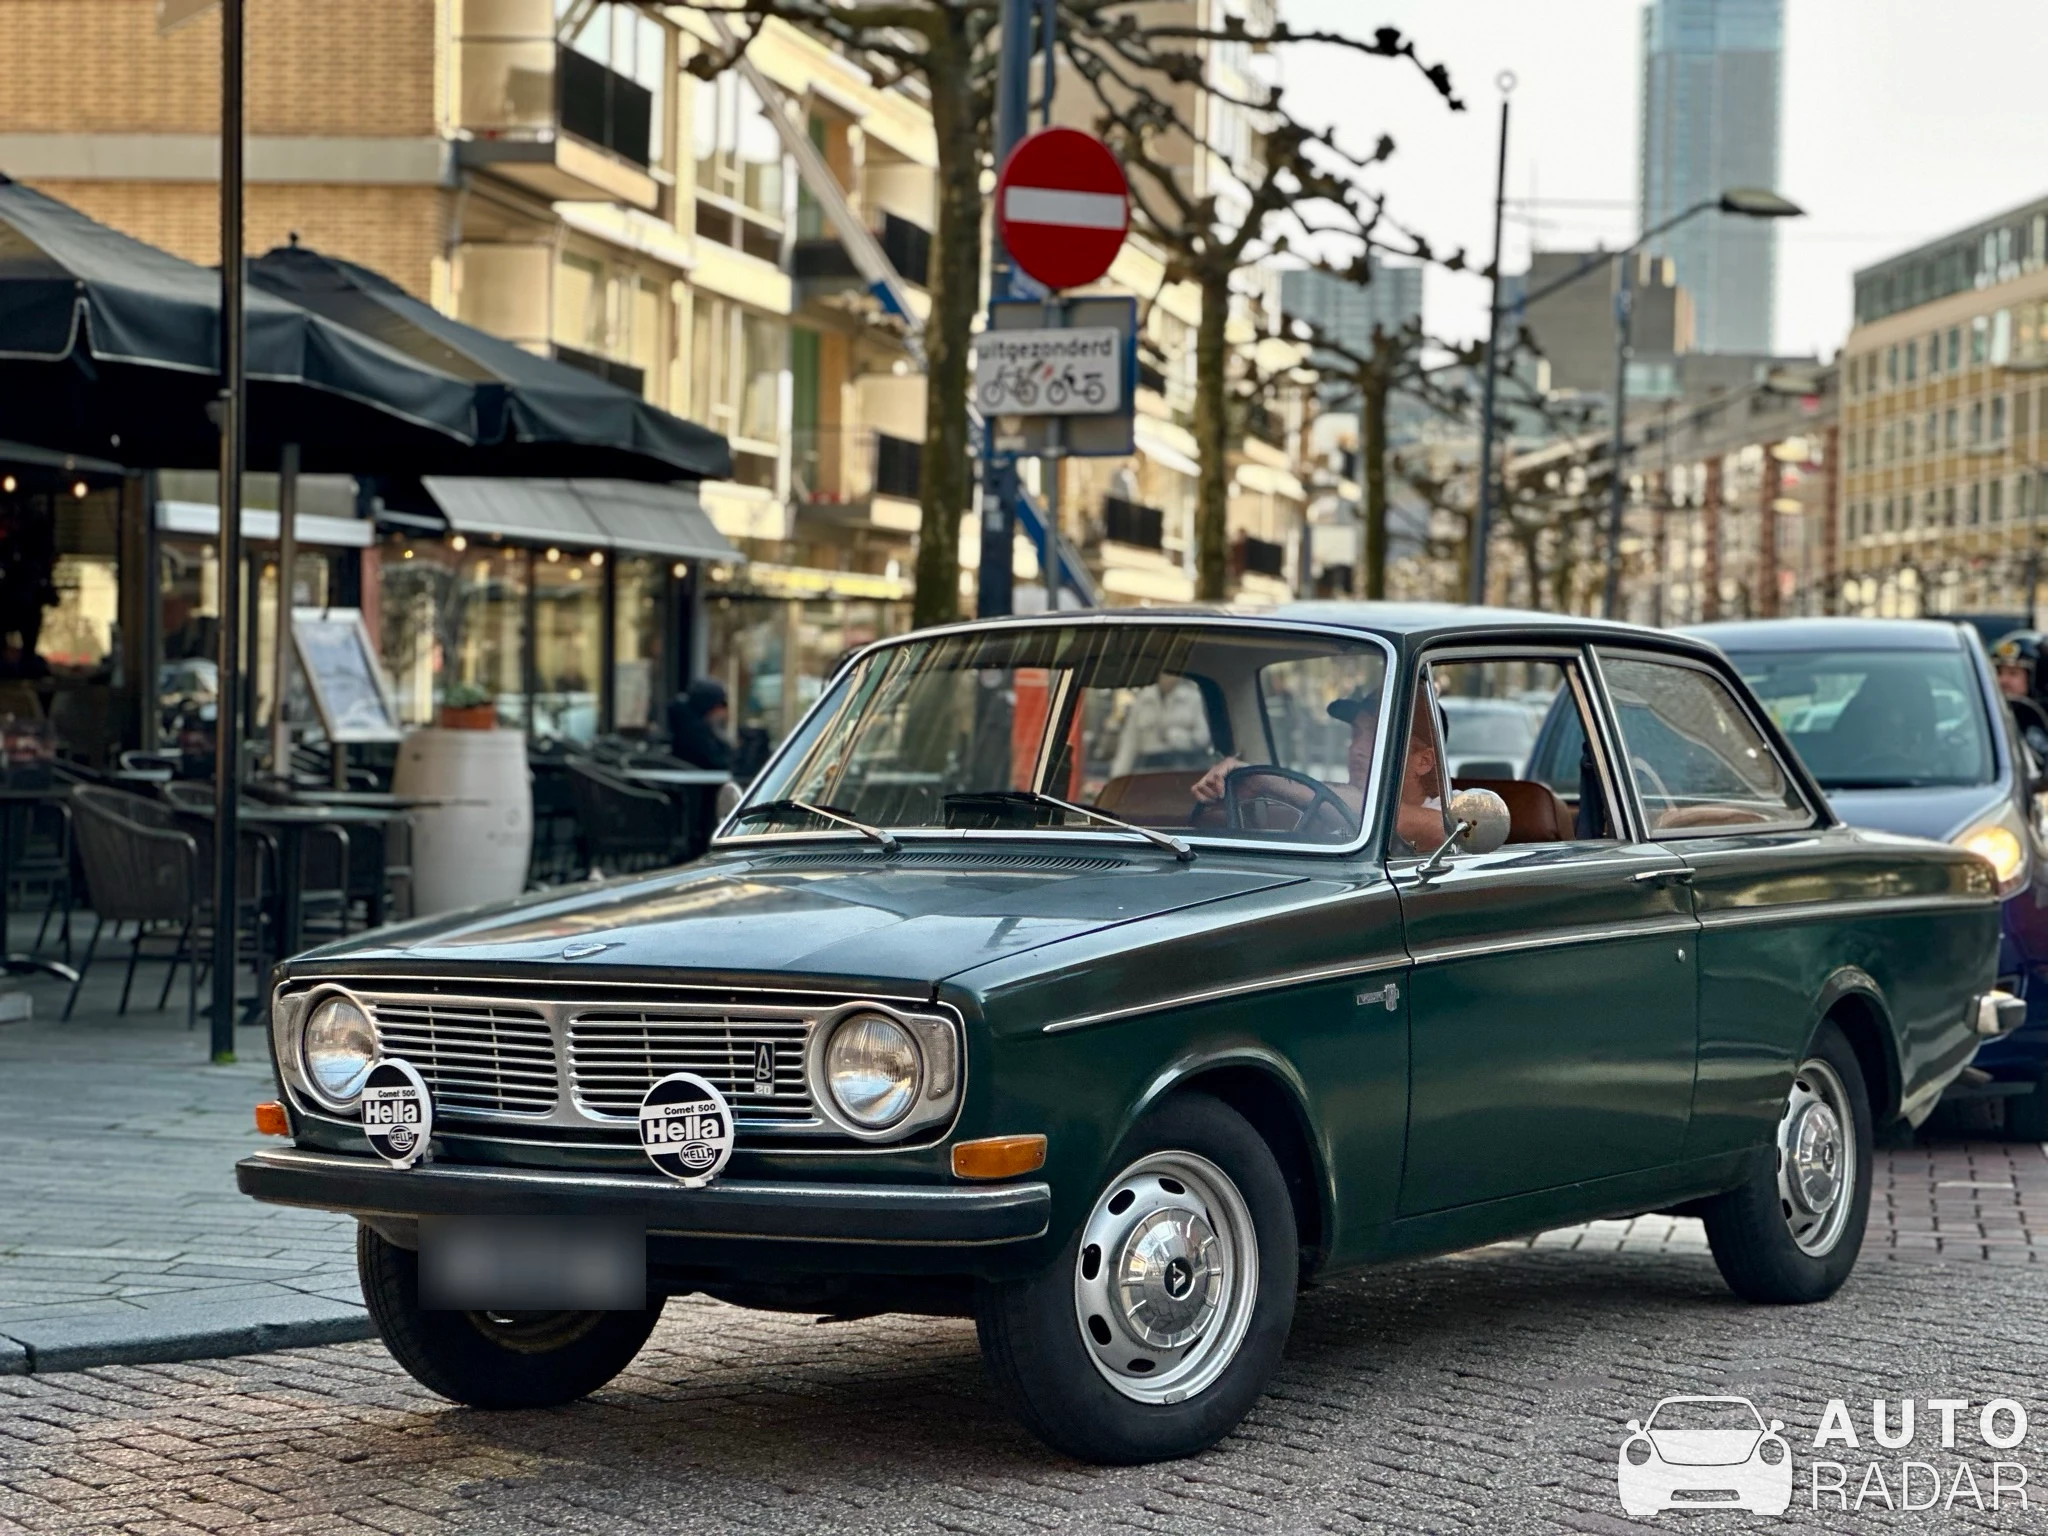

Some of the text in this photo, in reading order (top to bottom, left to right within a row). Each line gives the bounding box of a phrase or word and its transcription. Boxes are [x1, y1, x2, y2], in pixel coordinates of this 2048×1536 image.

[978, 337, 1113, 363] uitgezonderd
[378, 1089, 416, 1099] Comet 500
[365, 1100, 418, 1123] Hella
[664, 1103, 716, 1116] Comet 500
[646, 1115, 720, 1144] Hella
[391, 1131, 414, 1142] HELLA
[683, 1147, 715, 1160] HELLA
